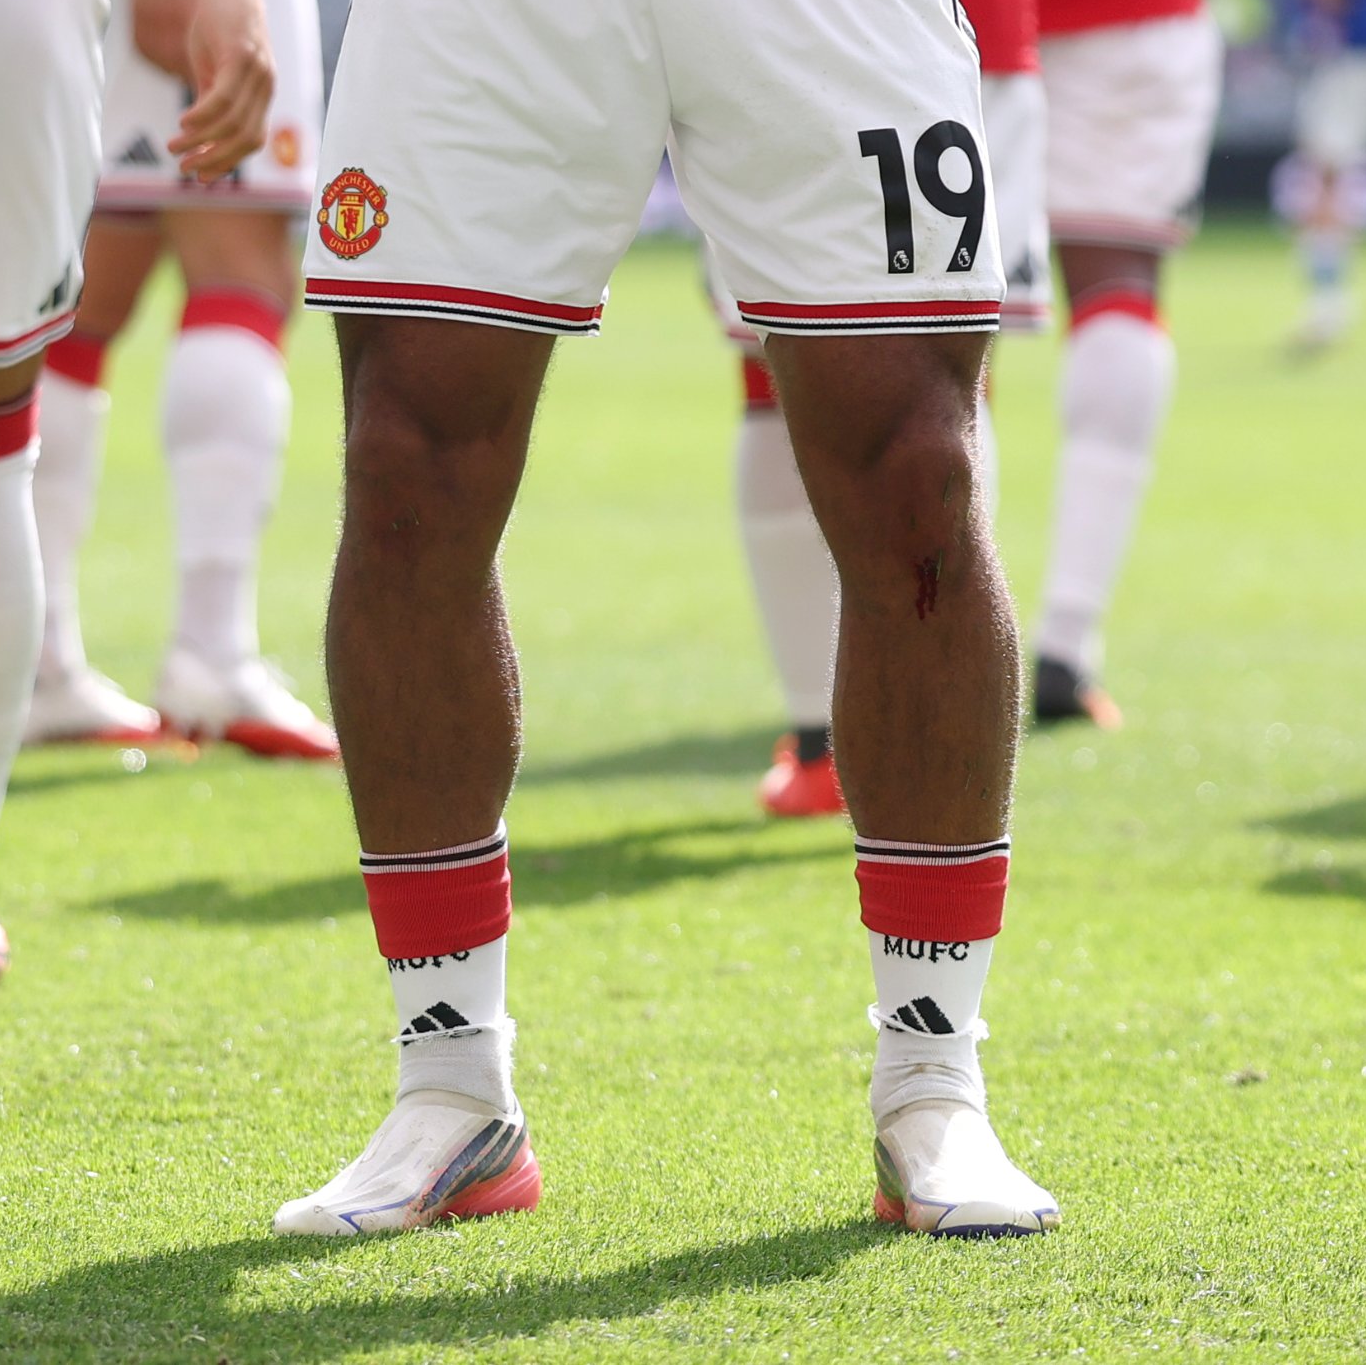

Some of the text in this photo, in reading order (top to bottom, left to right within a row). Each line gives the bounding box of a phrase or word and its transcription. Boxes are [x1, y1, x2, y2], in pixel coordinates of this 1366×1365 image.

[326, 175, 381, 205] MANCHESTER
[857, 120, 985, 274] 19
[329, 237, 369, 253] UNITED
[884, 935, 969, 963] MUFC
